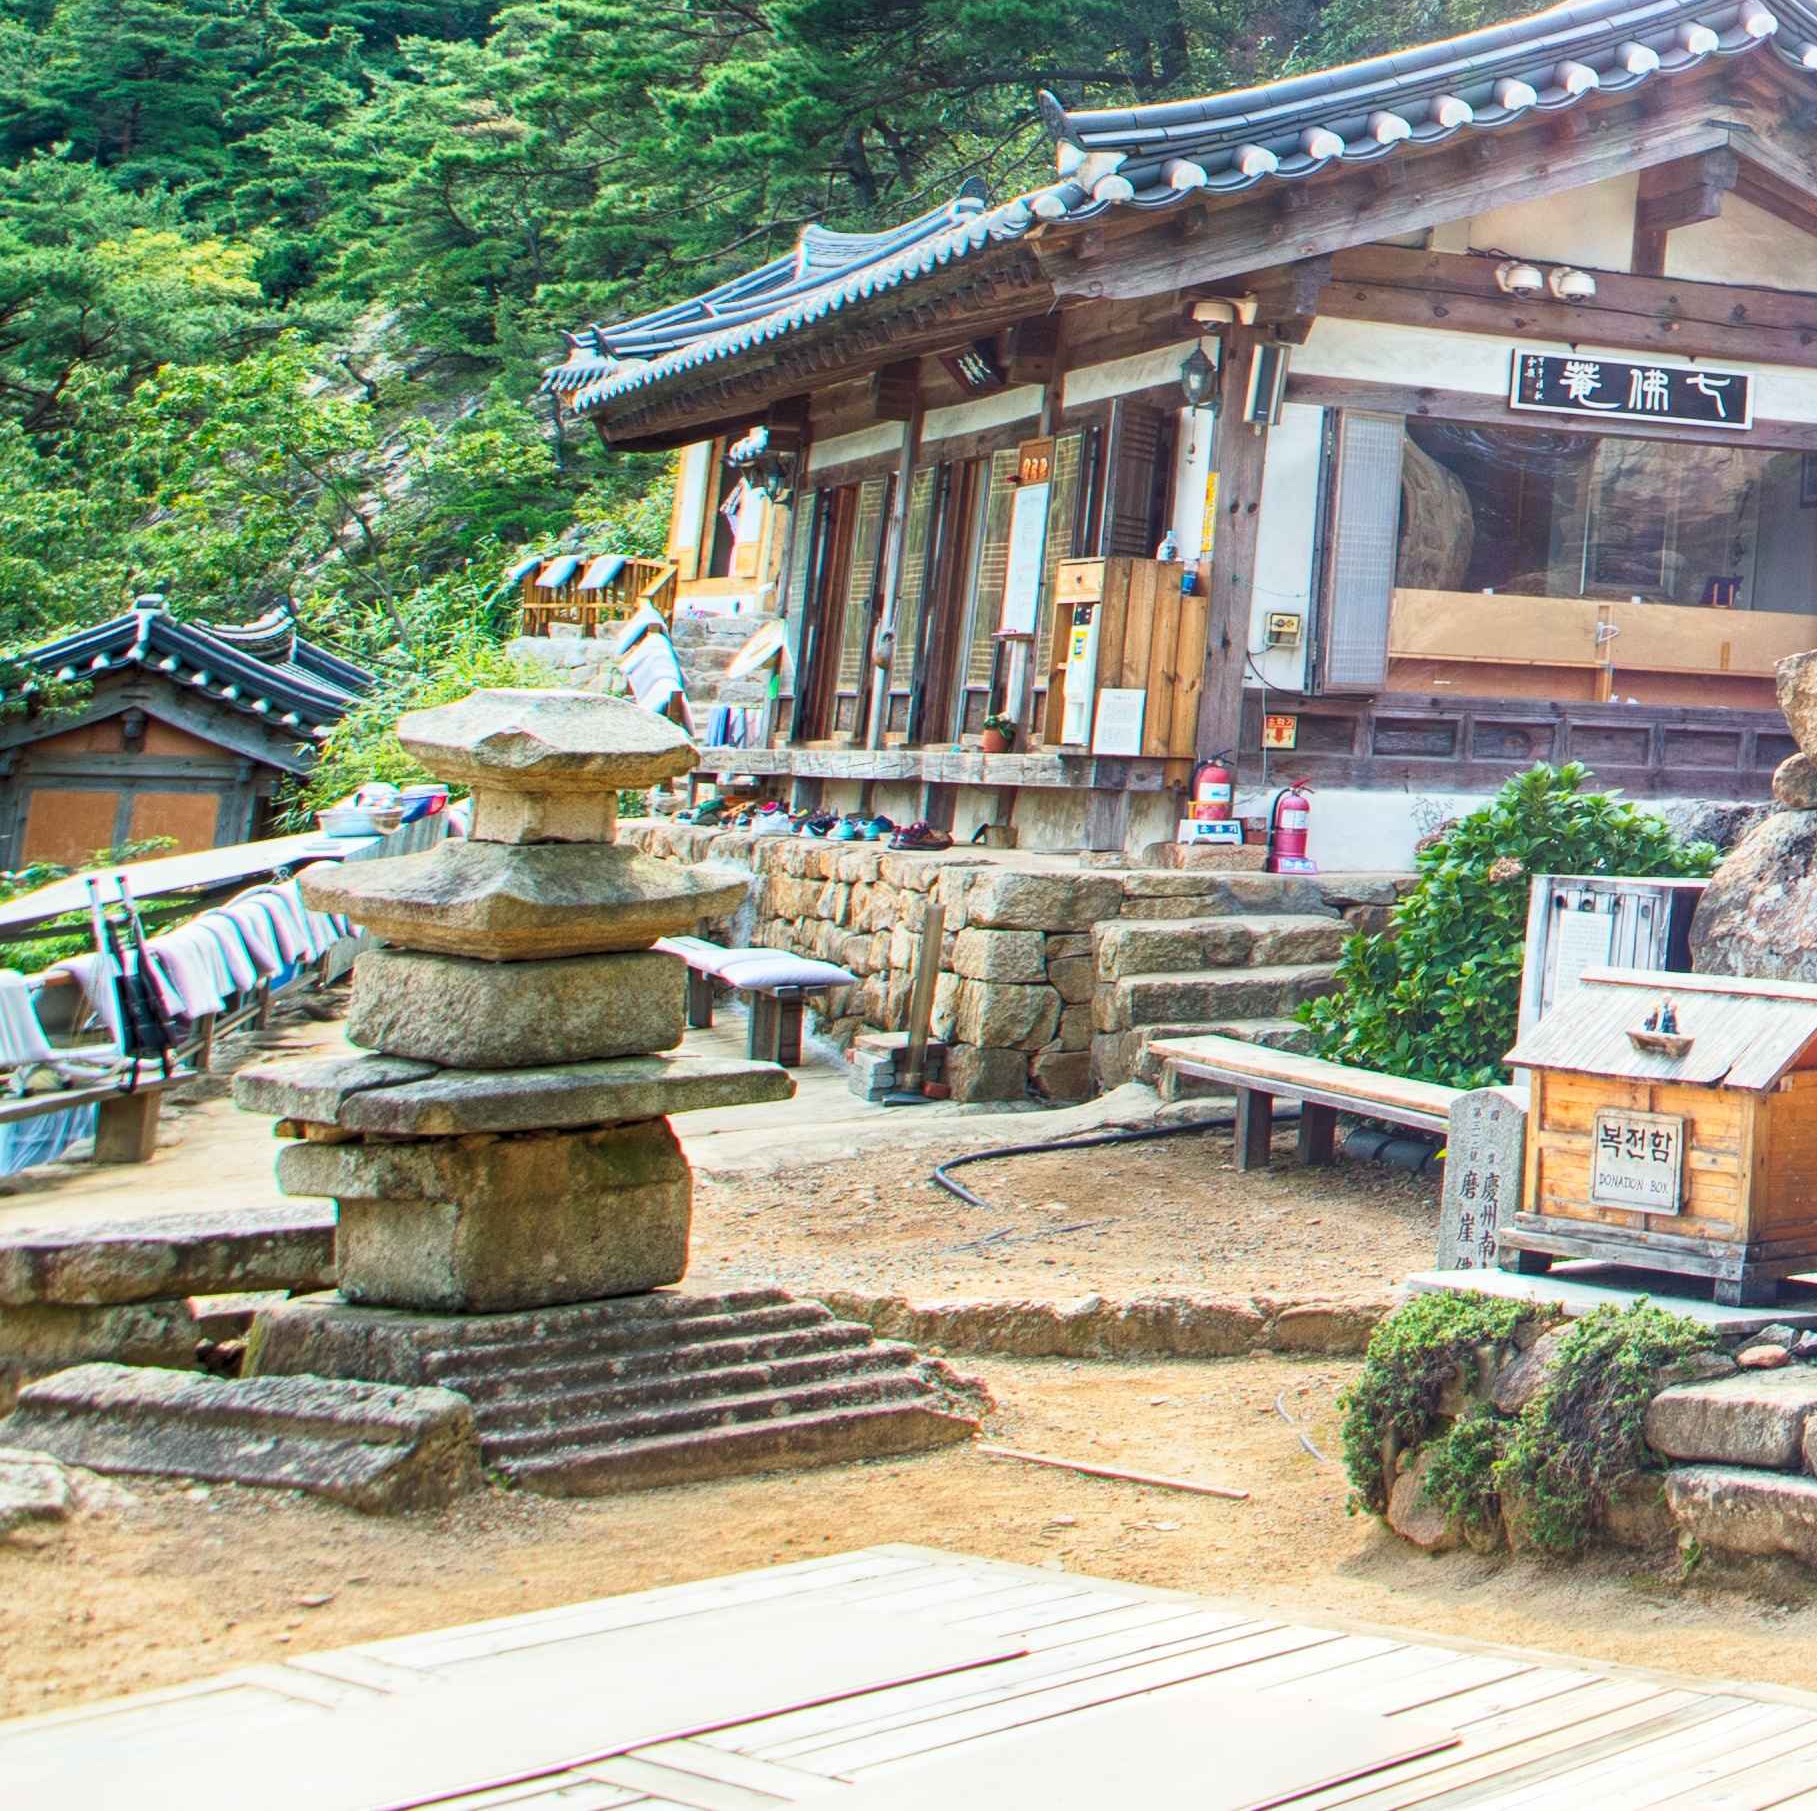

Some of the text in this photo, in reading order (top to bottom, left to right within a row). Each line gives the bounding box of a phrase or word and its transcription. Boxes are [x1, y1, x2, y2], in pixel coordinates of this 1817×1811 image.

[1560, 360, 1730, 418] 七佛菴
[1267, 717, 1295, 728] 소화기
[1600, 1124, 1672, 1163] 복전함
[1599, 1173, 1644, 1191] DONATION
[1480, 1171, 1500, 1269] 慶州南
